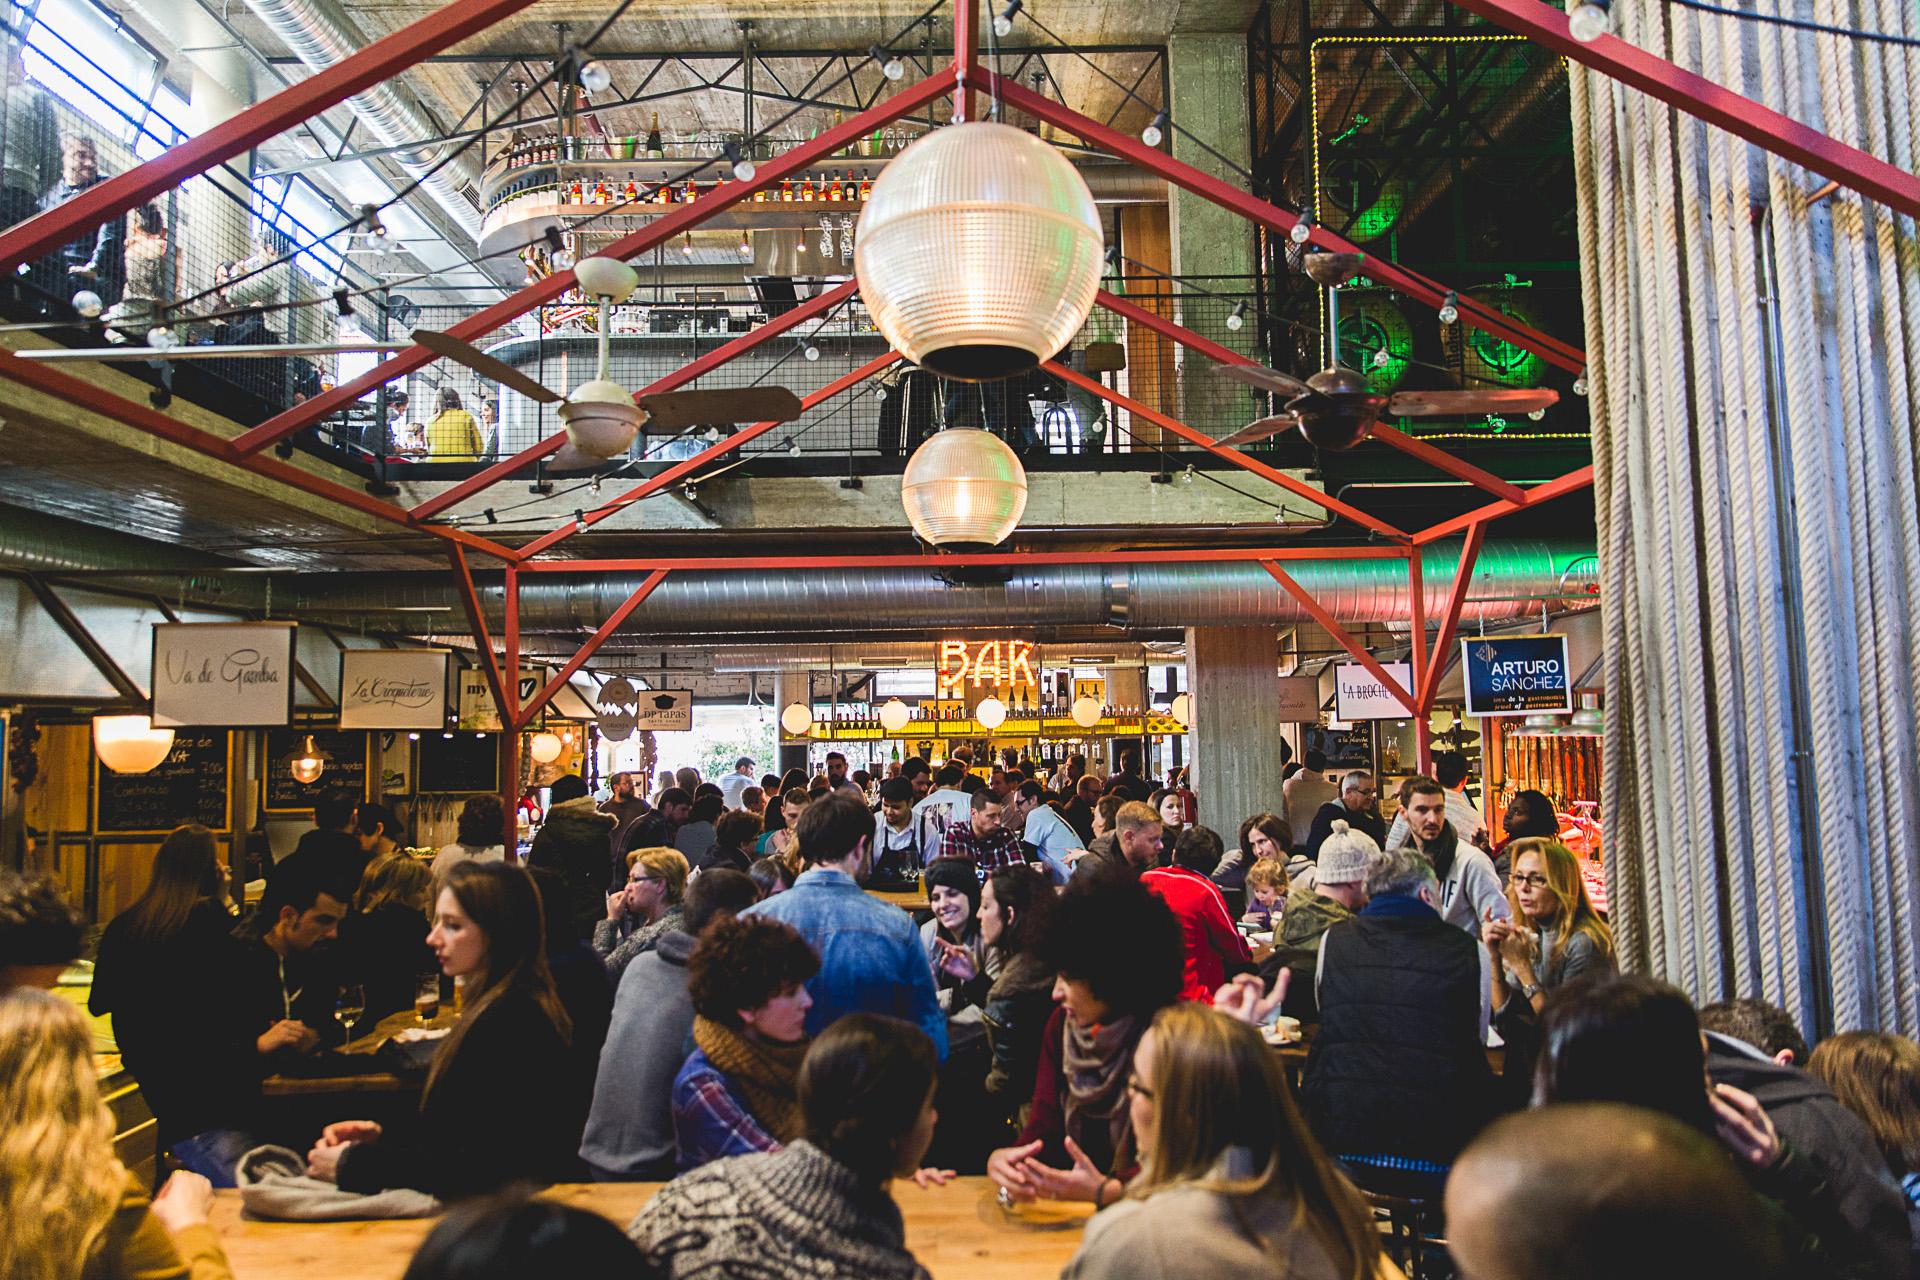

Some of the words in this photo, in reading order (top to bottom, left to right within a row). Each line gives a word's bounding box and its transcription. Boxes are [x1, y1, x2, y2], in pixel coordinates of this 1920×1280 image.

[198, 658, 214, 684] de
[221, 649, 279, 694] Gamba
[941, 639, 1036, 688] BAR
[1491, 659, 1559, 676] ARTURO
[467, 685, 488, 698] my
[1491, 674, 1564, 692] SÁNCHEZ
[644, 710, 656, 718] DP
